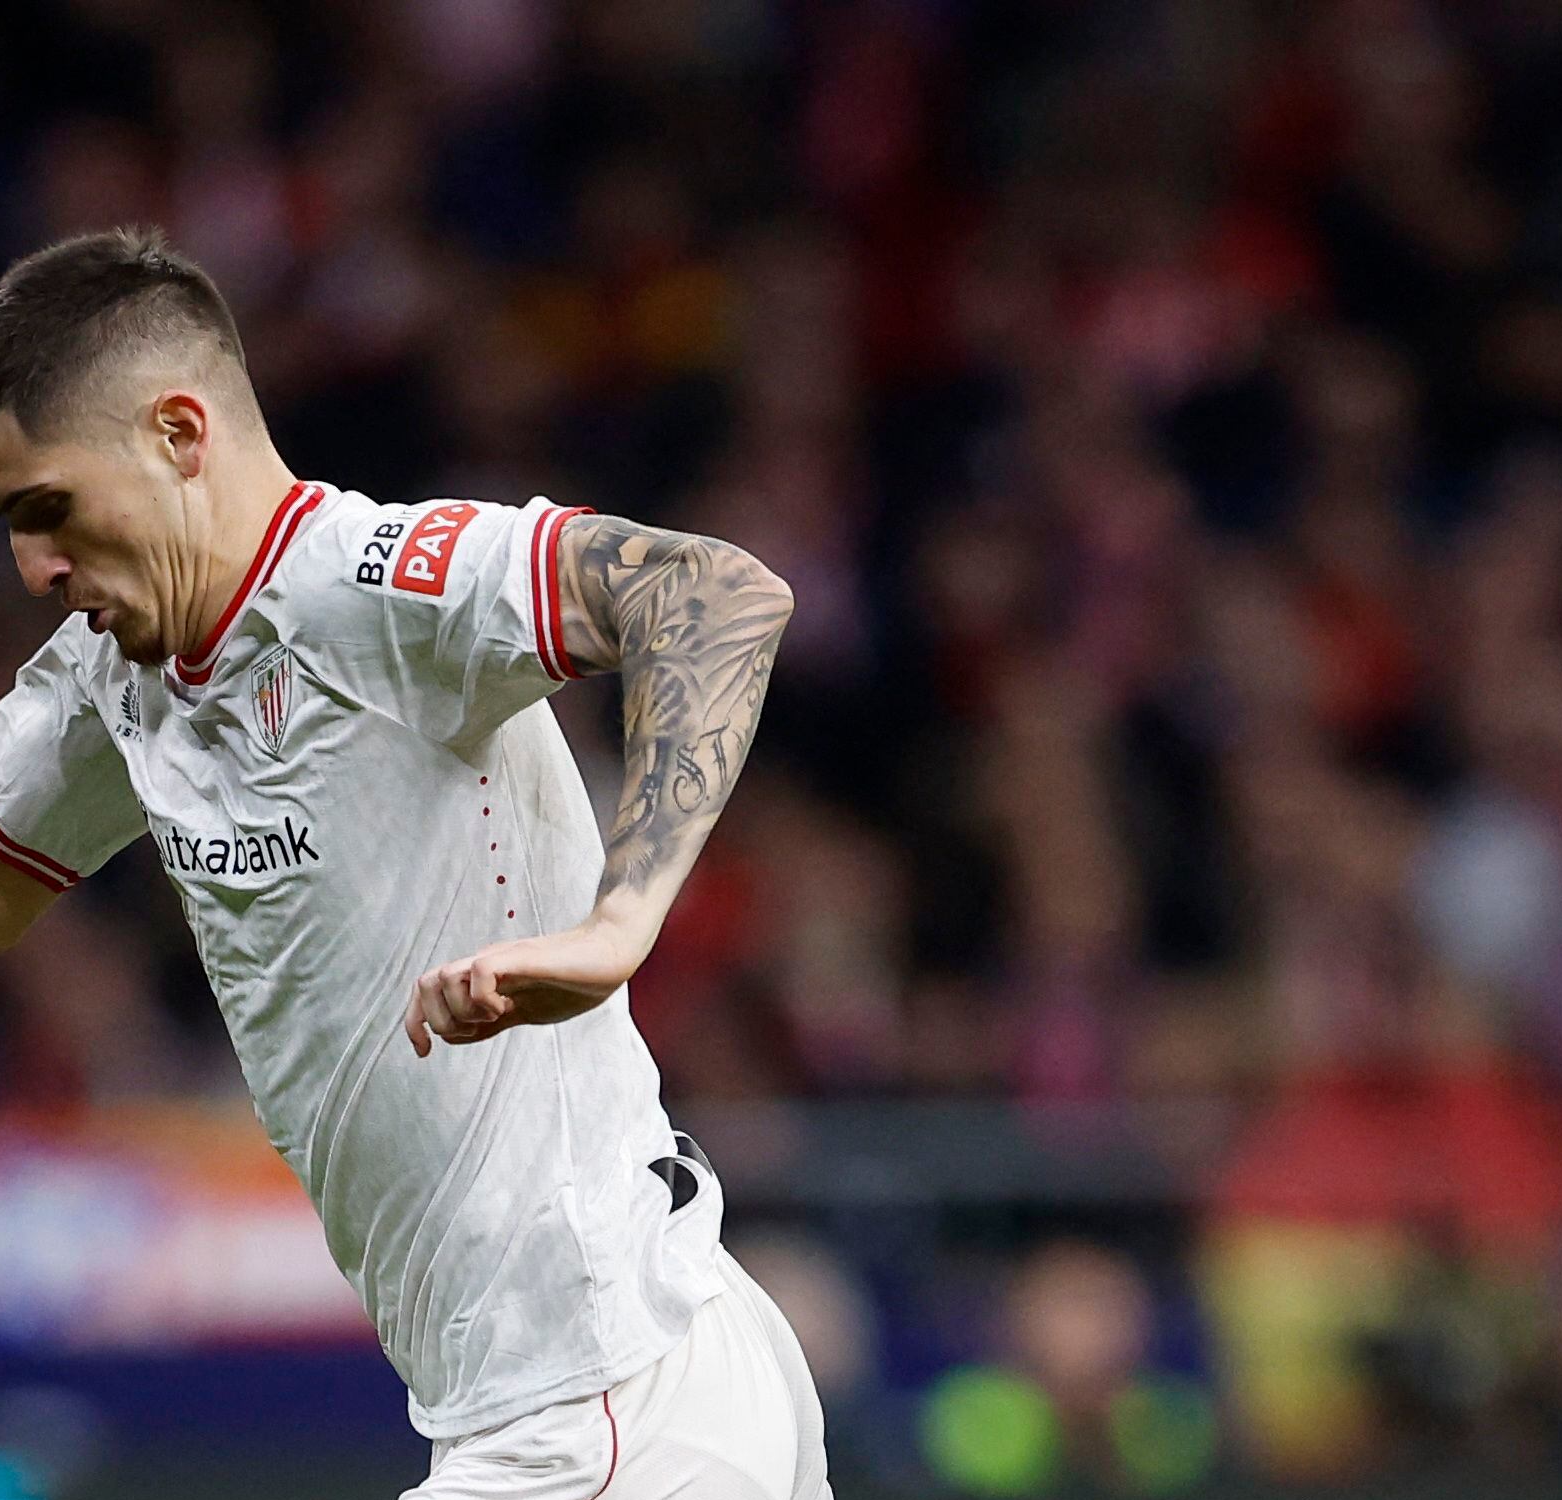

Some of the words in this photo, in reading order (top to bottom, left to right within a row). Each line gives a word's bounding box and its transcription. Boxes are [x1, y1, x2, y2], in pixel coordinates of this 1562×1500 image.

[356, 523, 404, 586] B2B
[404, 514, 459, 582] PAY
[142, 808, 320, 876] utxabank
